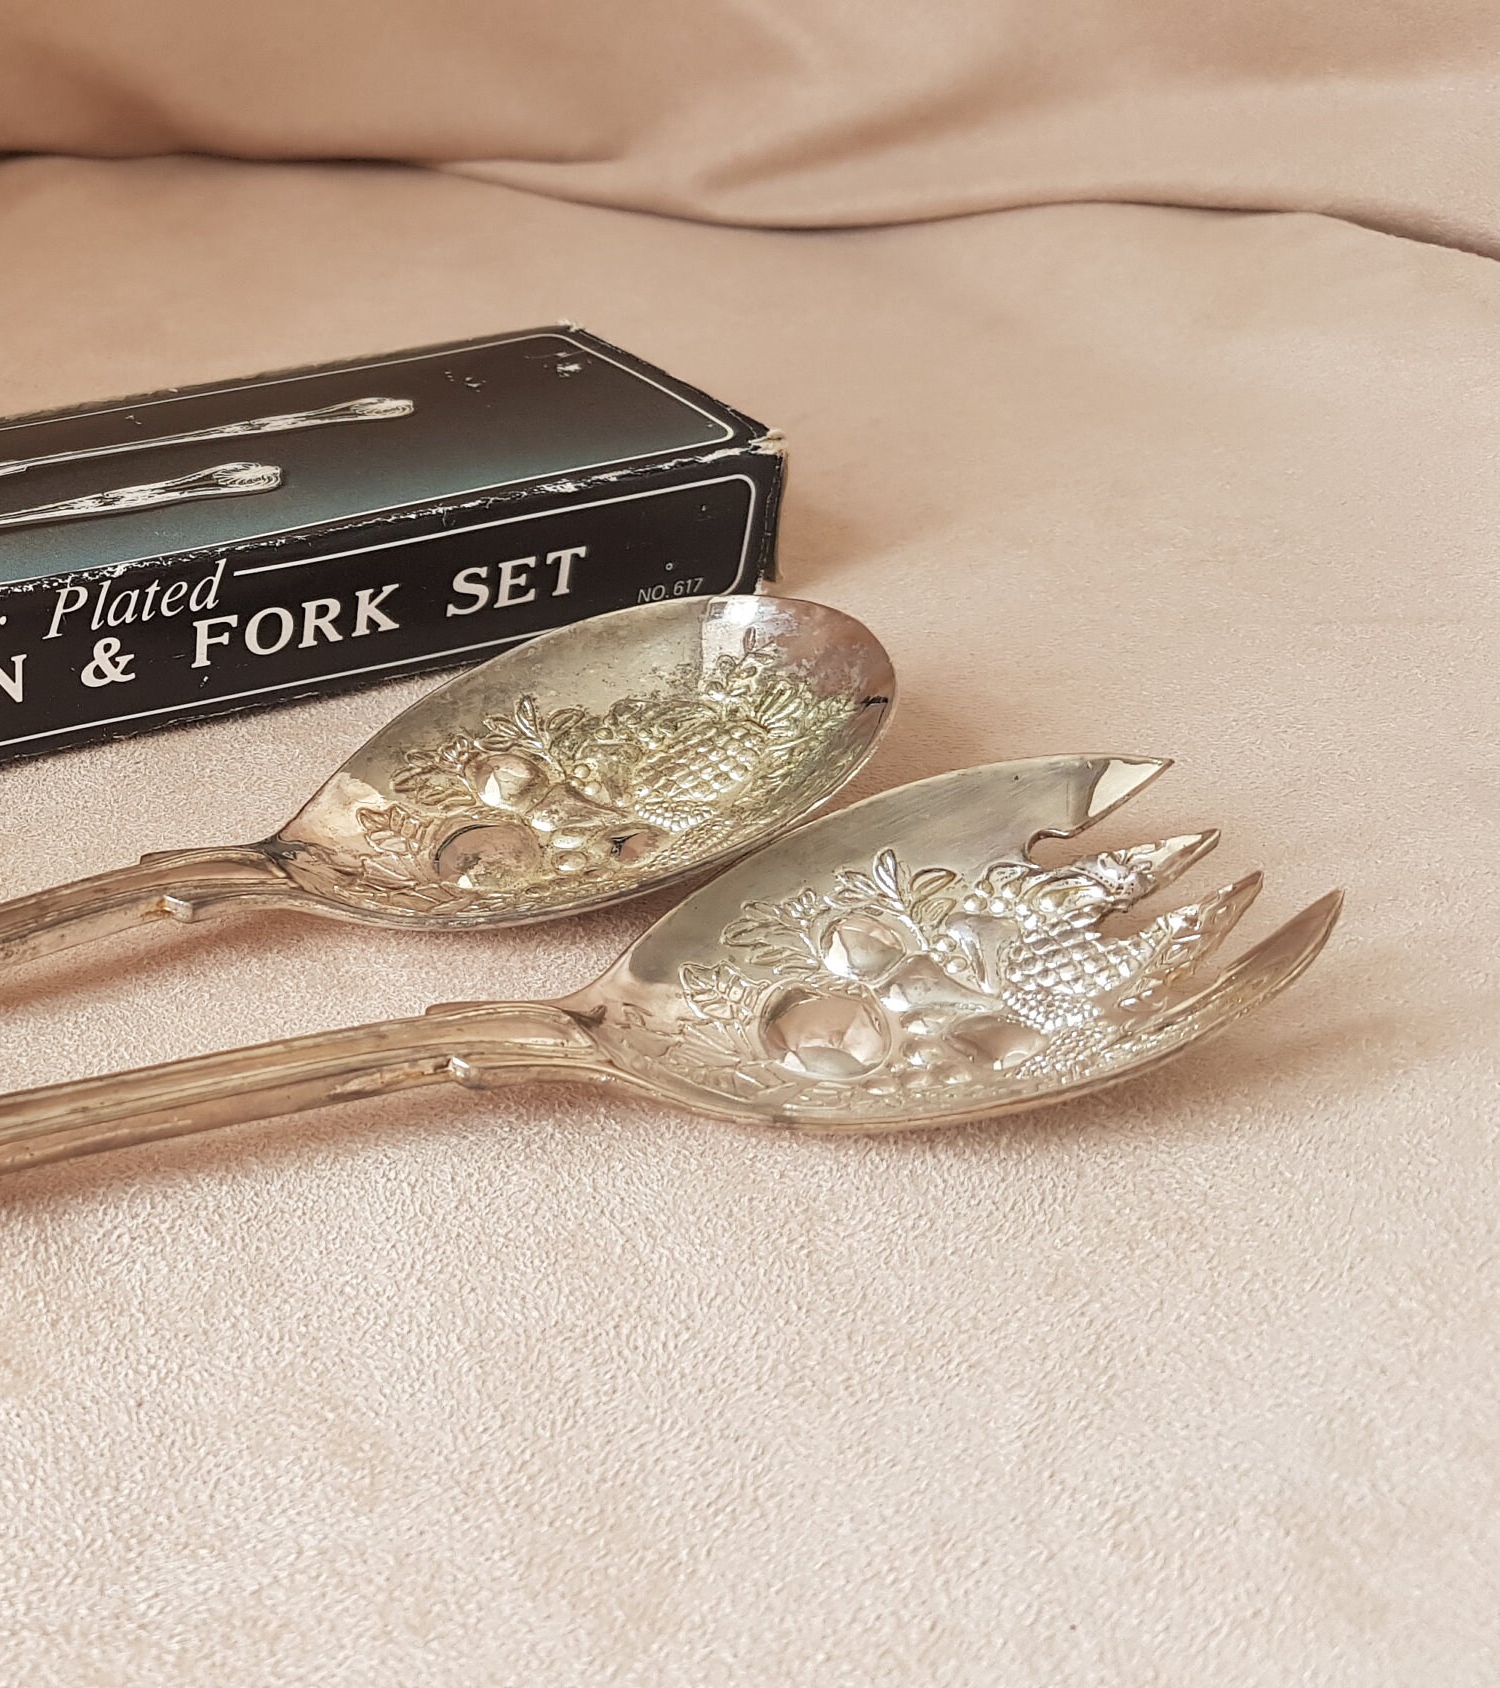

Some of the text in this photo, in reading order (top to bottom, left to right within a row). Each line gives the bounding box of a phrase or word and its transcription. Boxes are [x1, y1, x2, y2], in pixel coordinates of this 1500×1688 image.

[43, 559, 227, 639] Plated
[80, 637, 135, 688] &
[191, 584, 400, 668] FORK
[446, 546, 588, 616] SET
[637, 577, 704, 604] NO. 617
